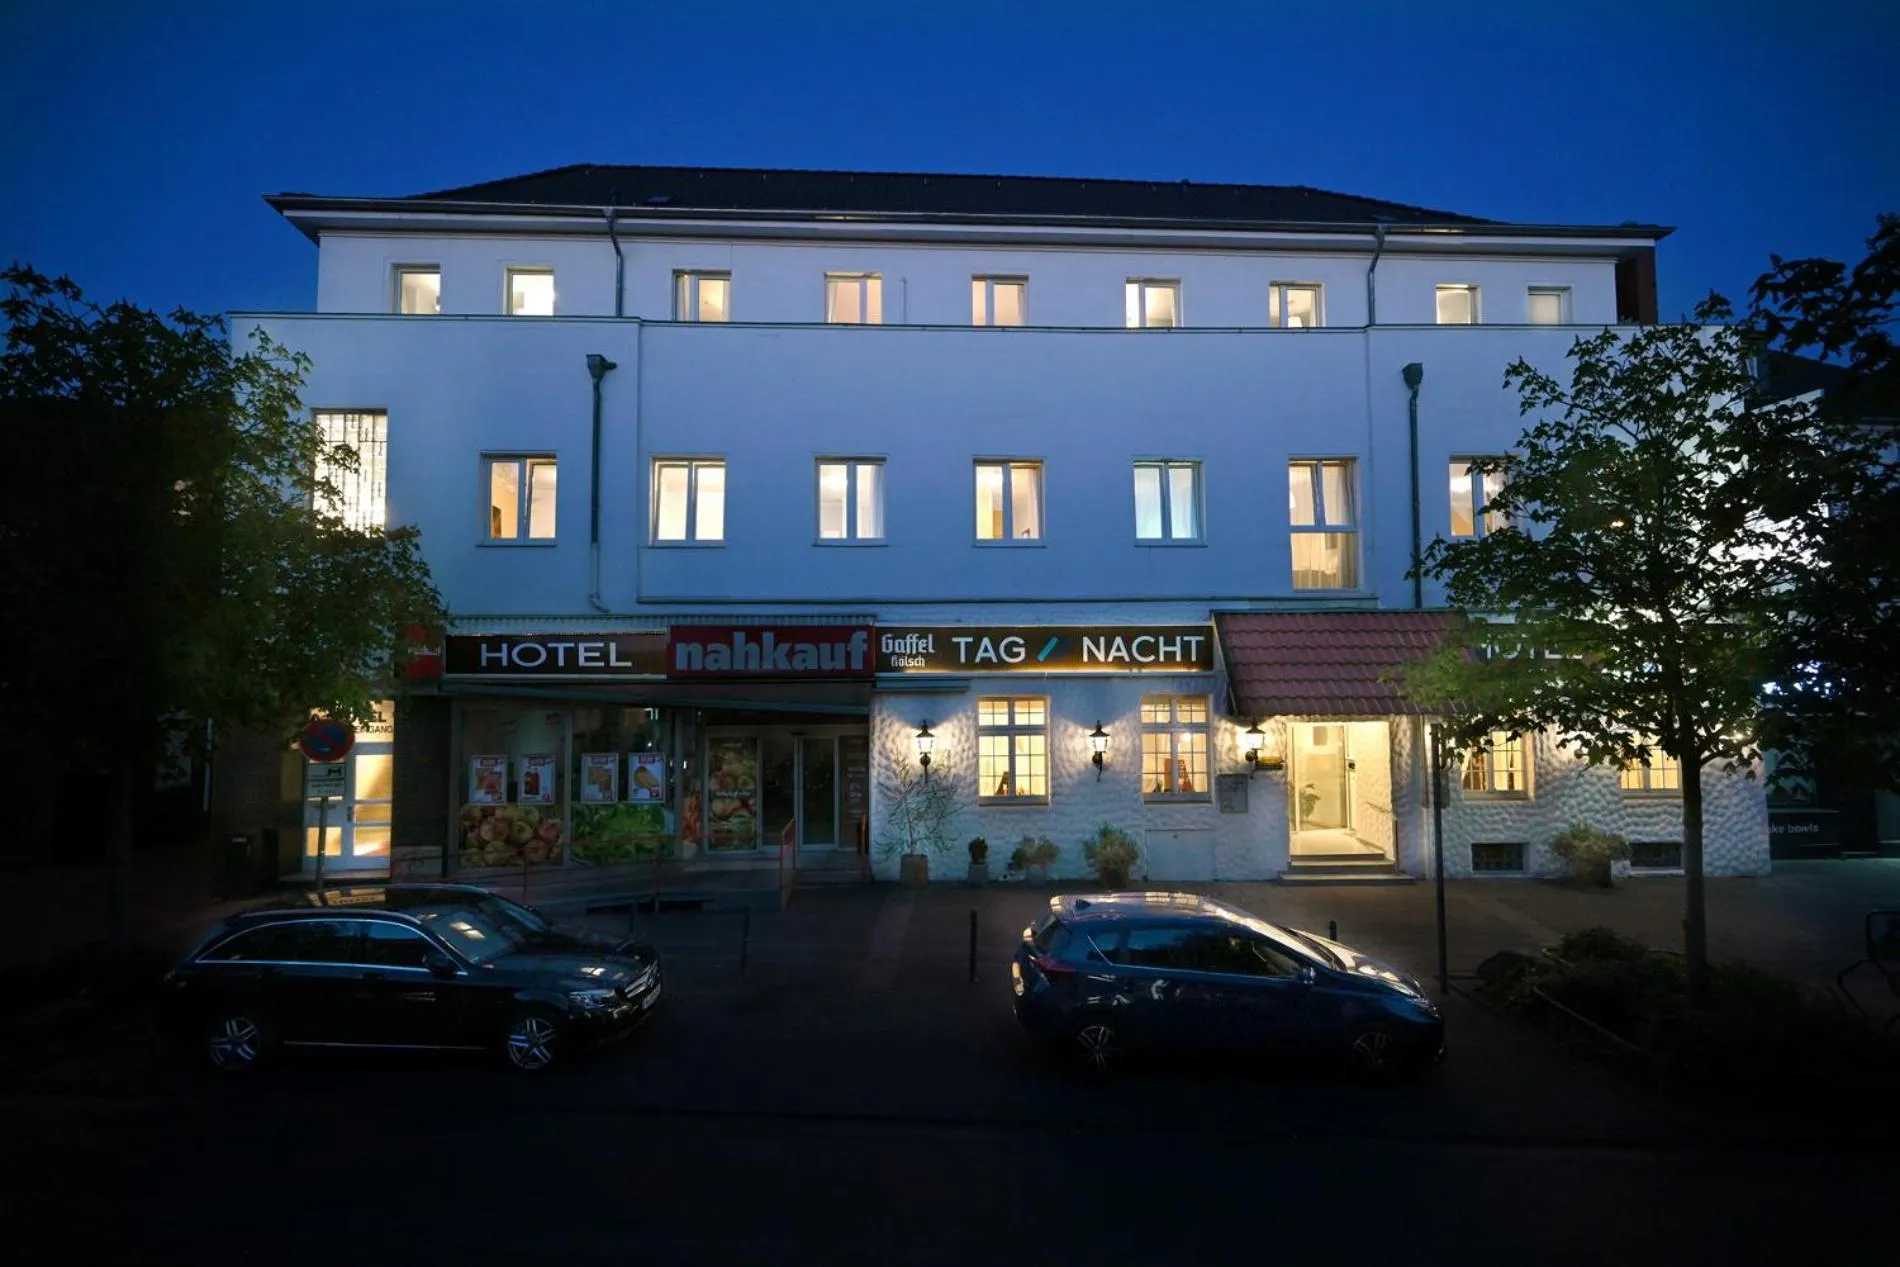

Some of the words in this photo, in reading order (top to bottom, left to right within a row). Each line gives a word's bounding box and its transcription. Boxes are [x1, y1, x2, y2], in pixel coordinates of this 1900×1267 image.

[480, 641, 633, 668] HOTEL
[675, 630, 869, 673] nahkauf
[880, 632, 936, 655] Gaffel
[952, 635, 1026, 664] TAG
[1082, 635, 1205, 664] NACHT
